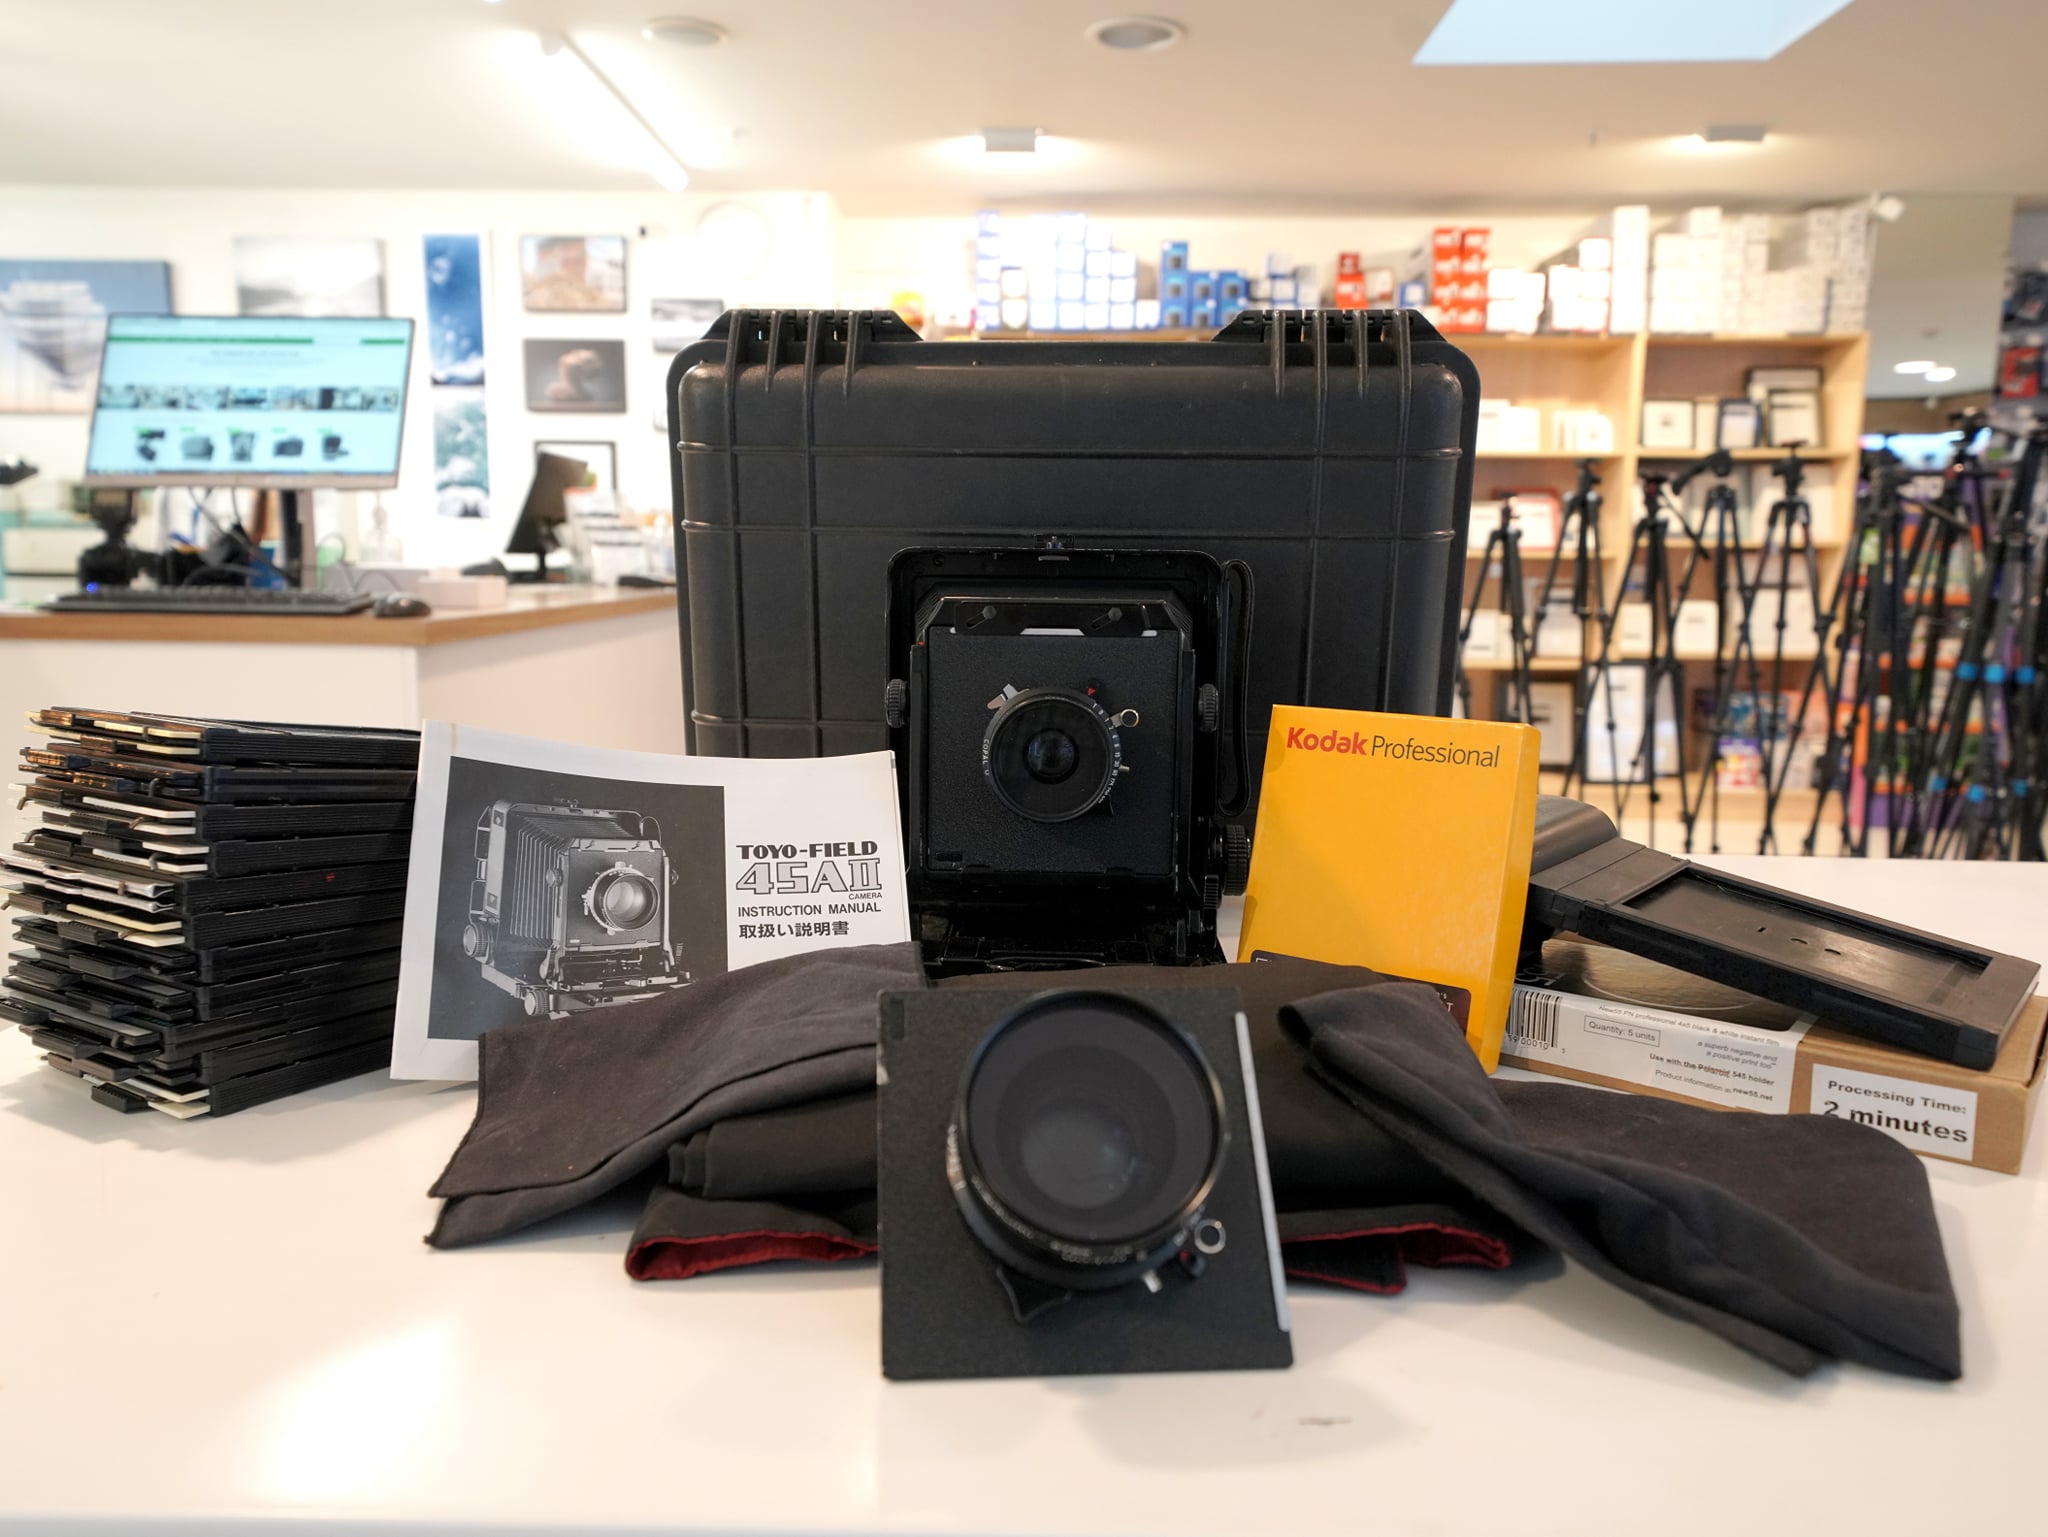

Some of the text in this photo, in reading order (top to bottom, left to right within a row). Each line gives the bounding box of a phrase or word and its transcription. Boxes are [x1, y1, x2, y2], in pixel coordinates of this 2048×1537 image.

[982, 738, 990, 765] COPAL
[1286, 726, 1500, 768] Kodak Professional
[735, 841, 878, 860] TOYO-FIELD
[848, 892, 883, 900] CAMERA
[738, 902, 881, 917] INSTRUCTION MANUAL
[738, 921, 849, 939] 取扱い説明書
[1589, 1020, 1656, 1042] Quantity: 5 units
[1635, 1012, 1676, 1026] professional
[1692, 1023, 1710, 1032] black
[1704, 1042, 1728, 1051] superb
[1730, 1047, 1761, 1058] negative
[1712, 1052, 1740, 1062] positive
[1650, 1053, 1664, 1061] Use
[1666, 1058, 1682, 1066] with
[1683, 1061, 1696, 1069] the
[1732, 1071, 1746, 1079] 545
[1748, 1074, 1775, 1085] holder
[1655, 1069, 1682, 1081] Product
[1684, 1077, 1723, 1091] information
[1732, 1087, 1773, 1101] new55.net
[1828, 1080, 1966, 1114] Processing Time:
[1824, 1101, 1967, 1143] 2 minutes
